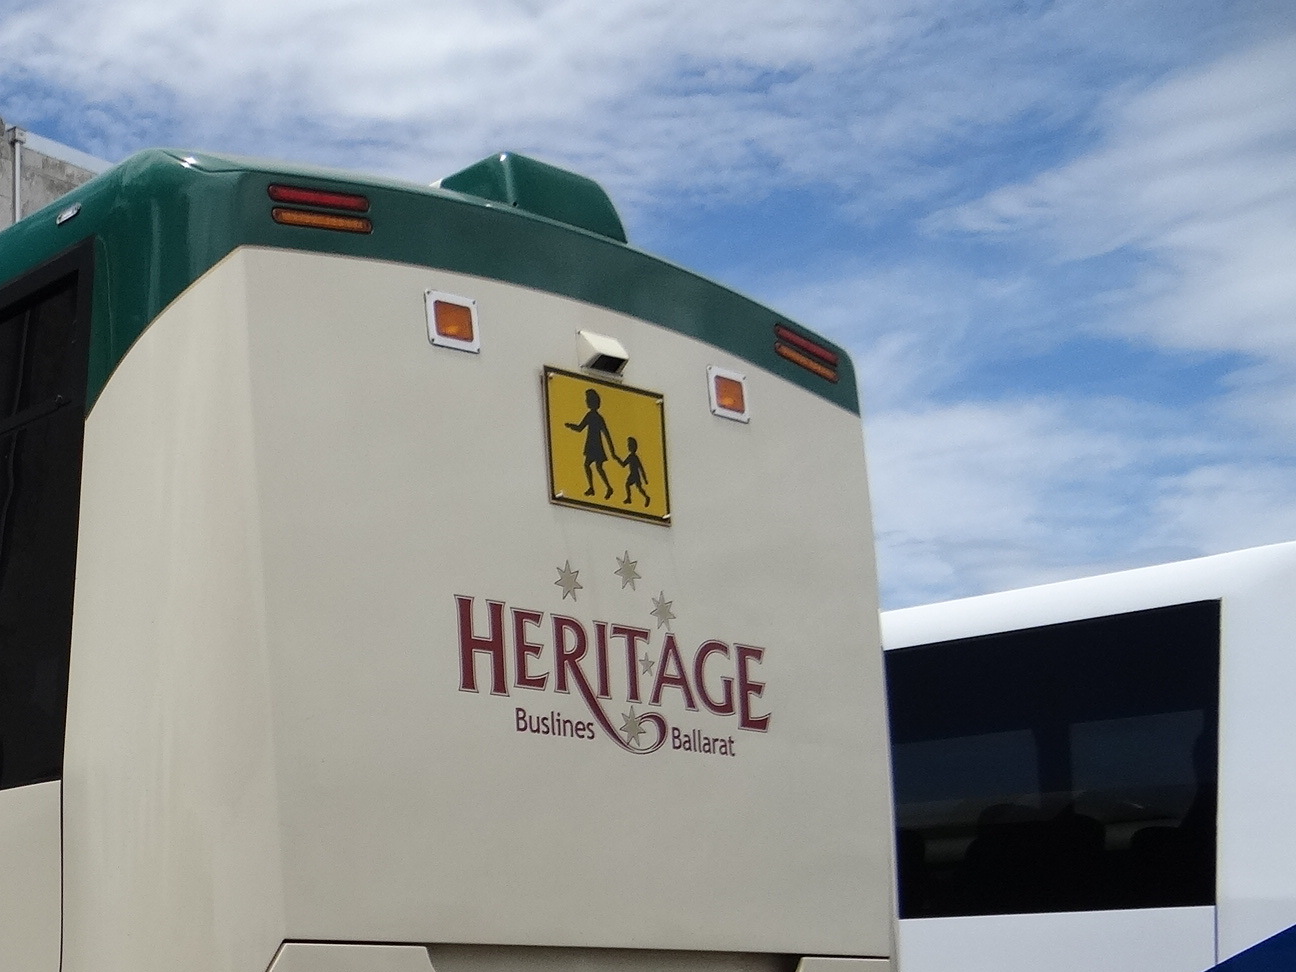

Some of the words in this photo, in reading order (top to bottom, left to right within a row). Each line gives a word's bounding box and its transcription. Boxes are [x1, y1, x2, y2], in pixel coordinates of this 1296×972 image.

[454, 594, 772, 755] HERITAGE
[515, 707, 595, 740] Buslines
[672, 726, 736, 757] Ballarat
